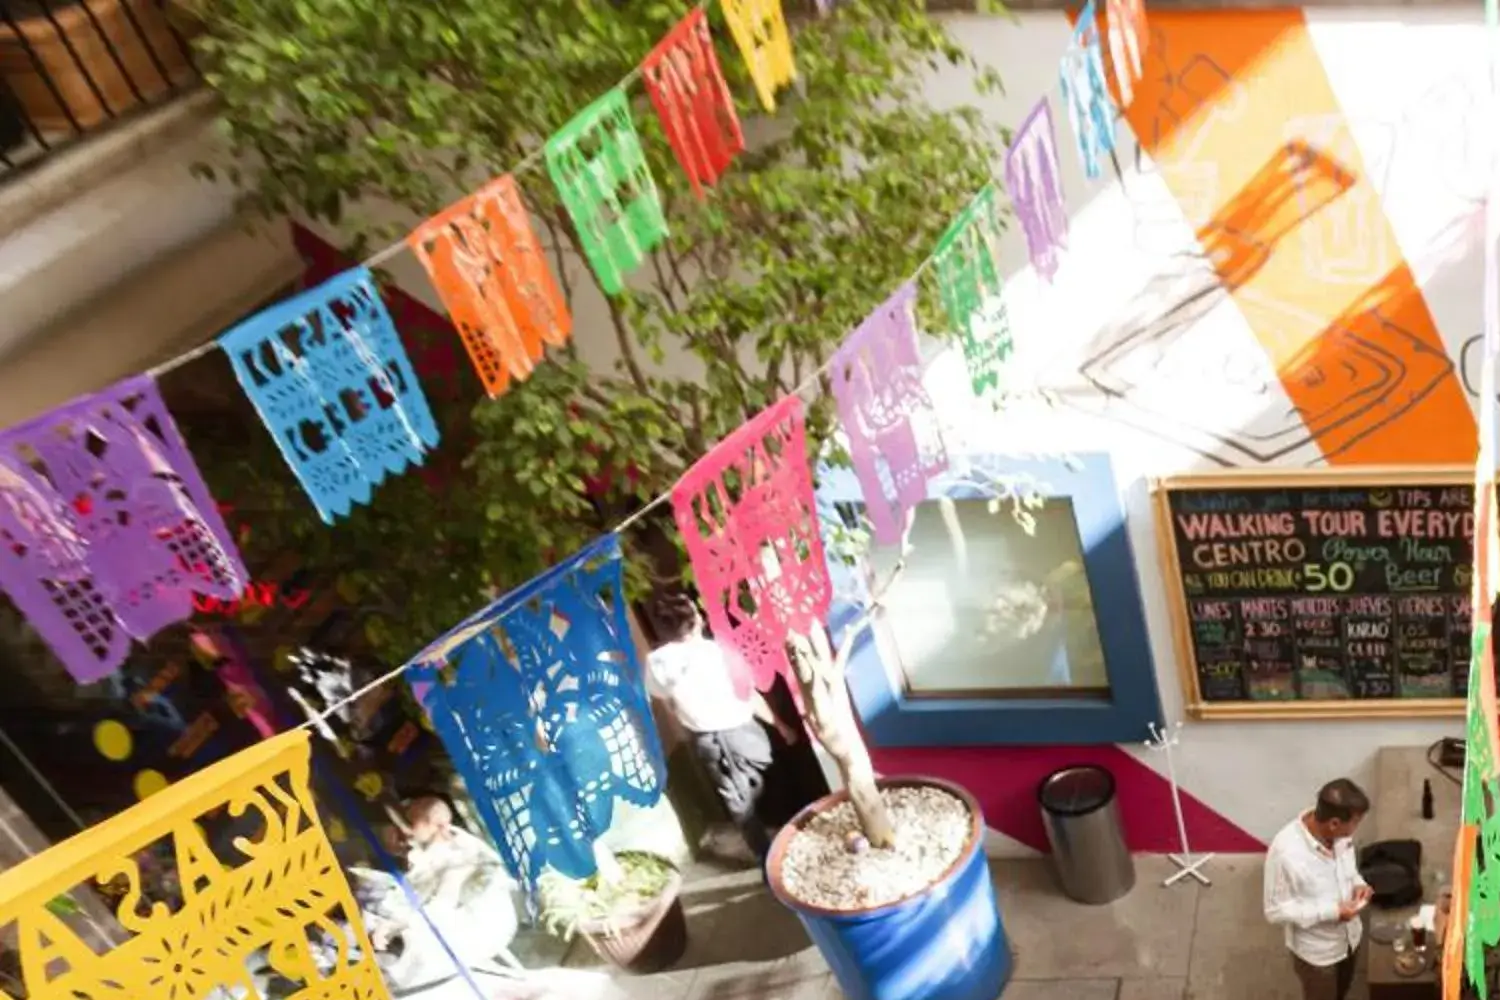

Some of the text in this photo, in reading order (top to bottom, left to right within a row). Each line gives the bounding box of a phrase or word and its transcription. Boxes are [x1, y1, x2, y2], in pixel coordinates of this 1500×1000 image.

[1397, 488, 1432, 507] TIPS
[1440, 487, 1469, 506] ARE
[1176, 511, 1296, 541] WALKING
[1301, 509, 1367, 537] TOUR
[1192, 537, 1306, 568] CENTRO
[1384, 561, 1443, 587] Beer
